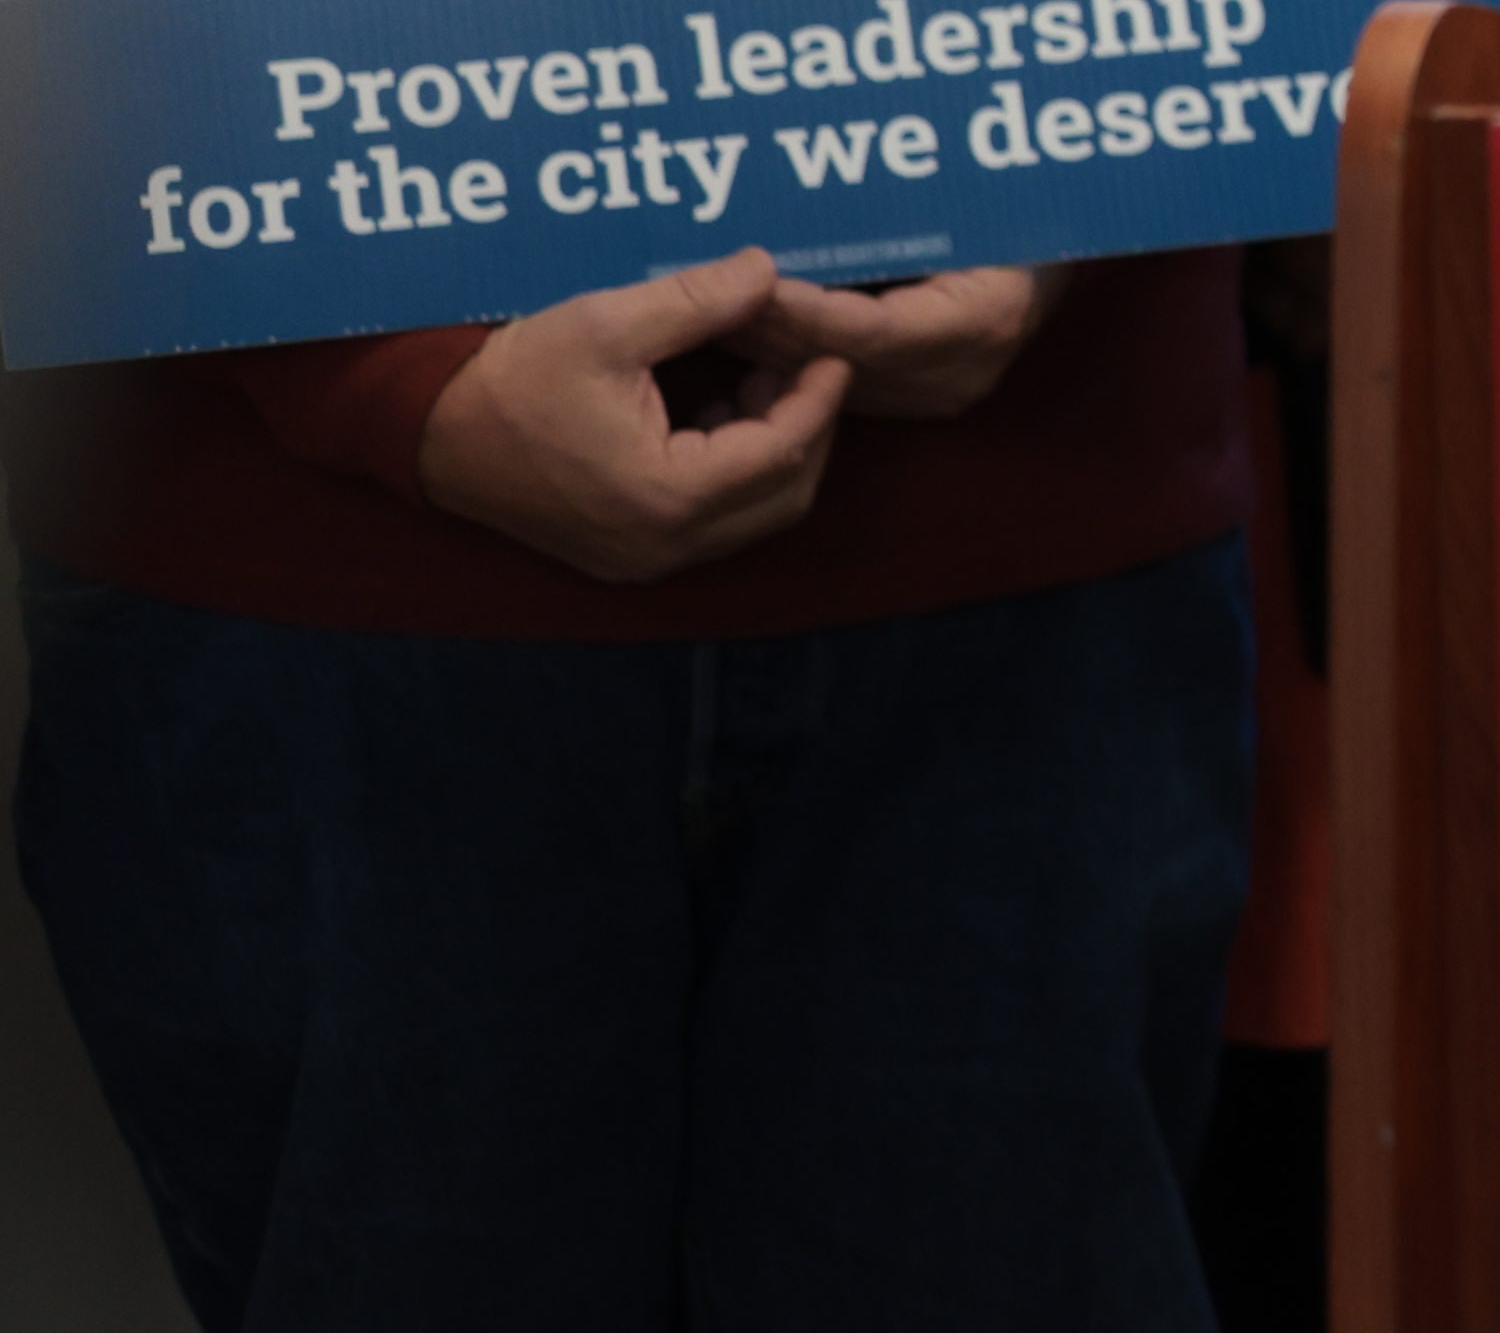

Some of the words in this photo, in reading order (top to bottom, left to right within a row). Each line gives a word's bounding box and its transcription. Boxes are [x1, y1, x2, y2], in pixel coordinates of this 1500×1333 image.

[267, 39, 668, 142] Proven
[140, 165, 300, 255] for
[328, 144, 508, 235] the
[537, 121, 749, 222] city
[773, 114, 940, 190] we
